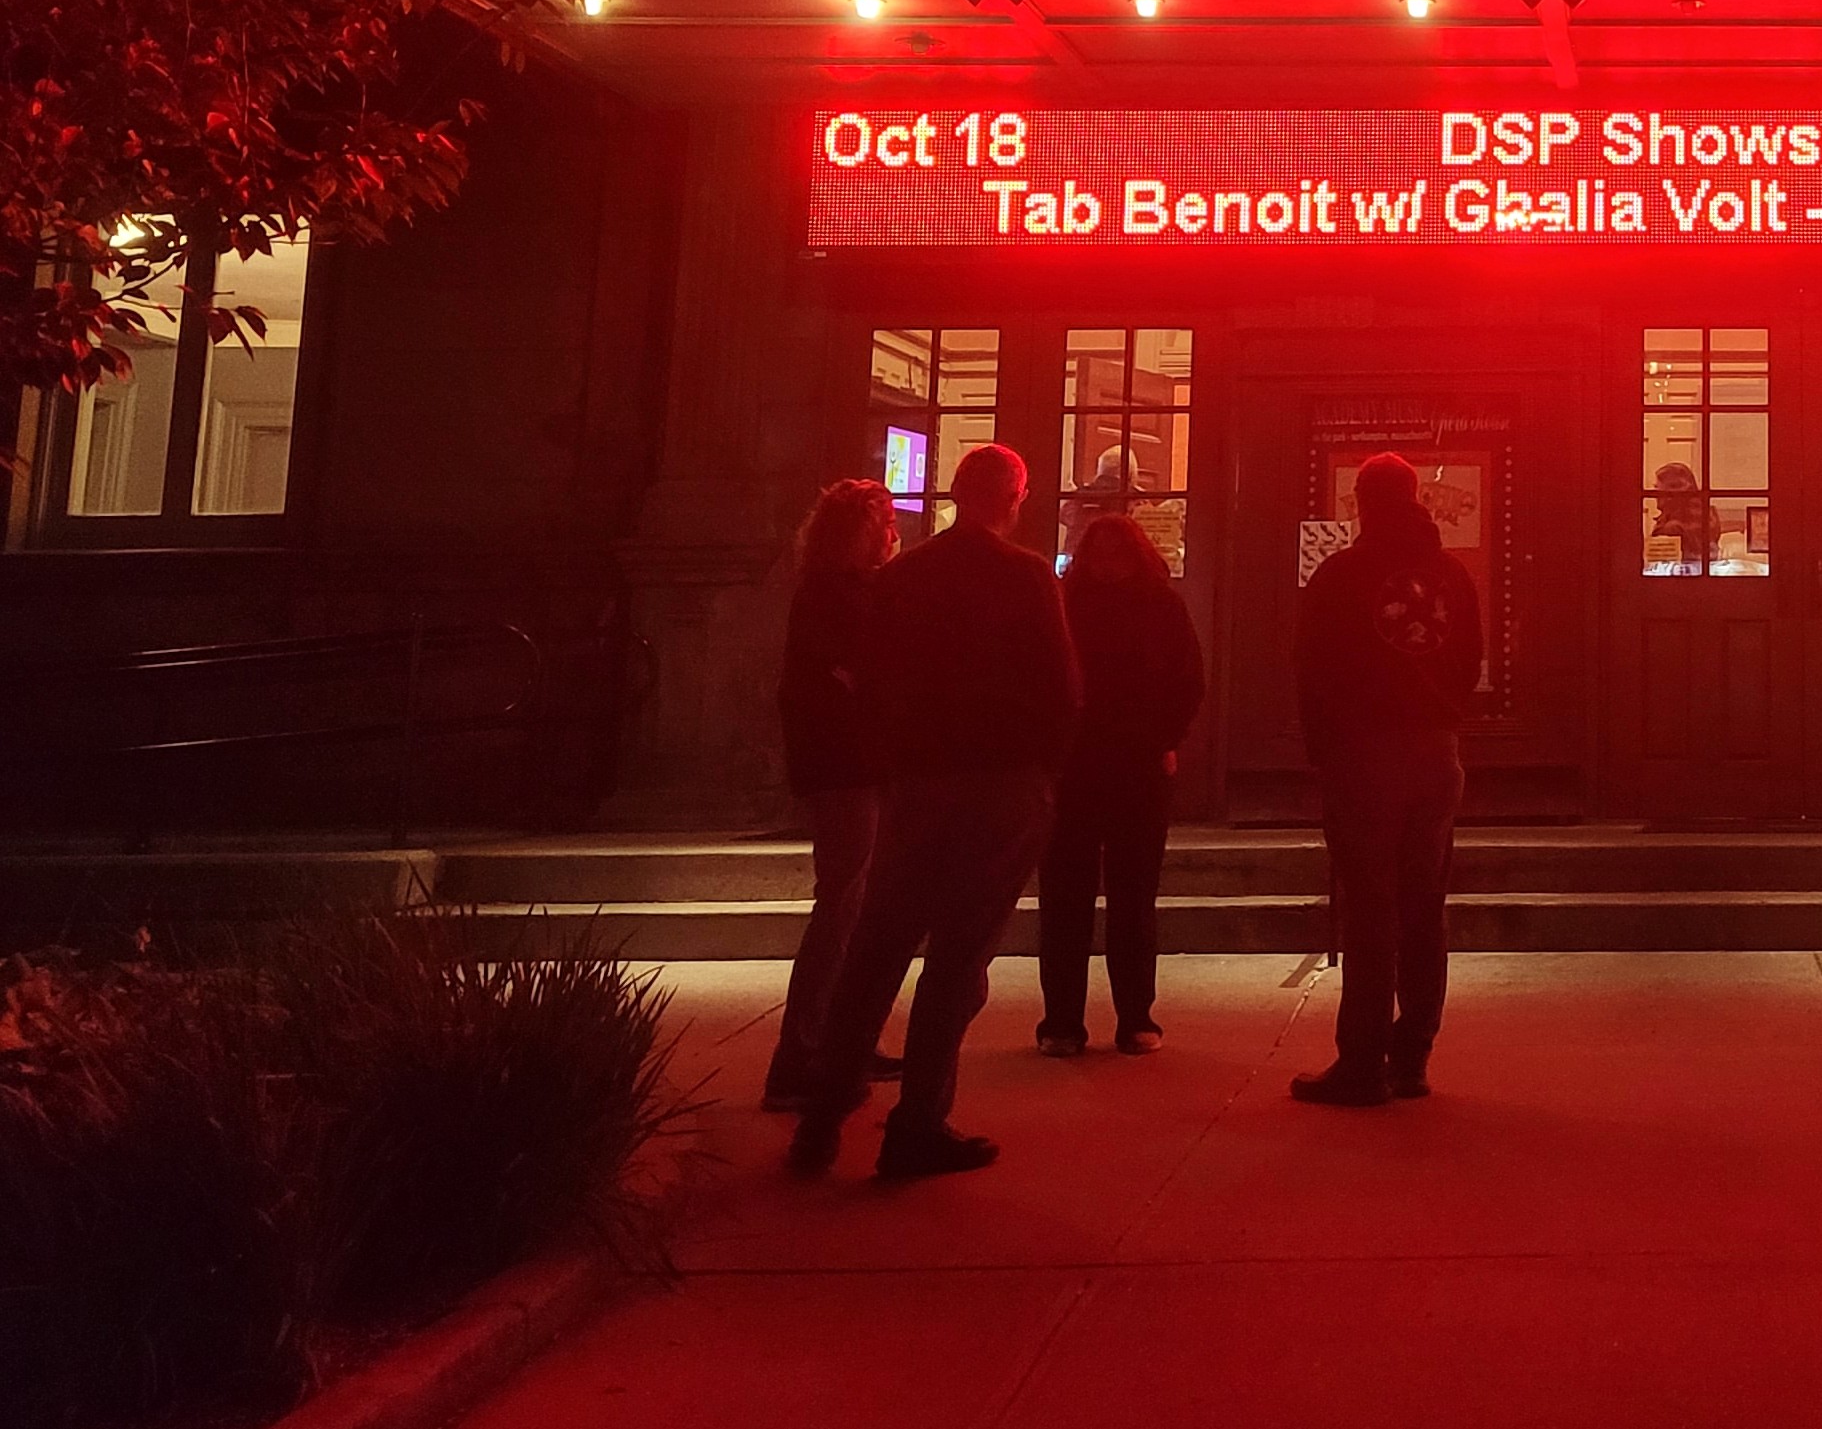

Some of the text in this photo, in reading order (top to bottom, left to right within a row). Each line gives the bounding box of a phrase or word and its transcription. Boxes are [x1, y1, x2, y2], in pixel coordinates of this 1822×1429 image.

[825, 114, 1026, 166] Oct 18
[1442, 113, 1579, 164] DSP
[1604, 114, 1819, 164] Shows
[984, 181, 1100, 233] Tab
[1124, 181, 1336, 233] Benoit
[1353, 181, 1425, 232] w/
[1445, 180, 1643, 231] Ghalia
[1664, 180, 1785, 231] Volt
